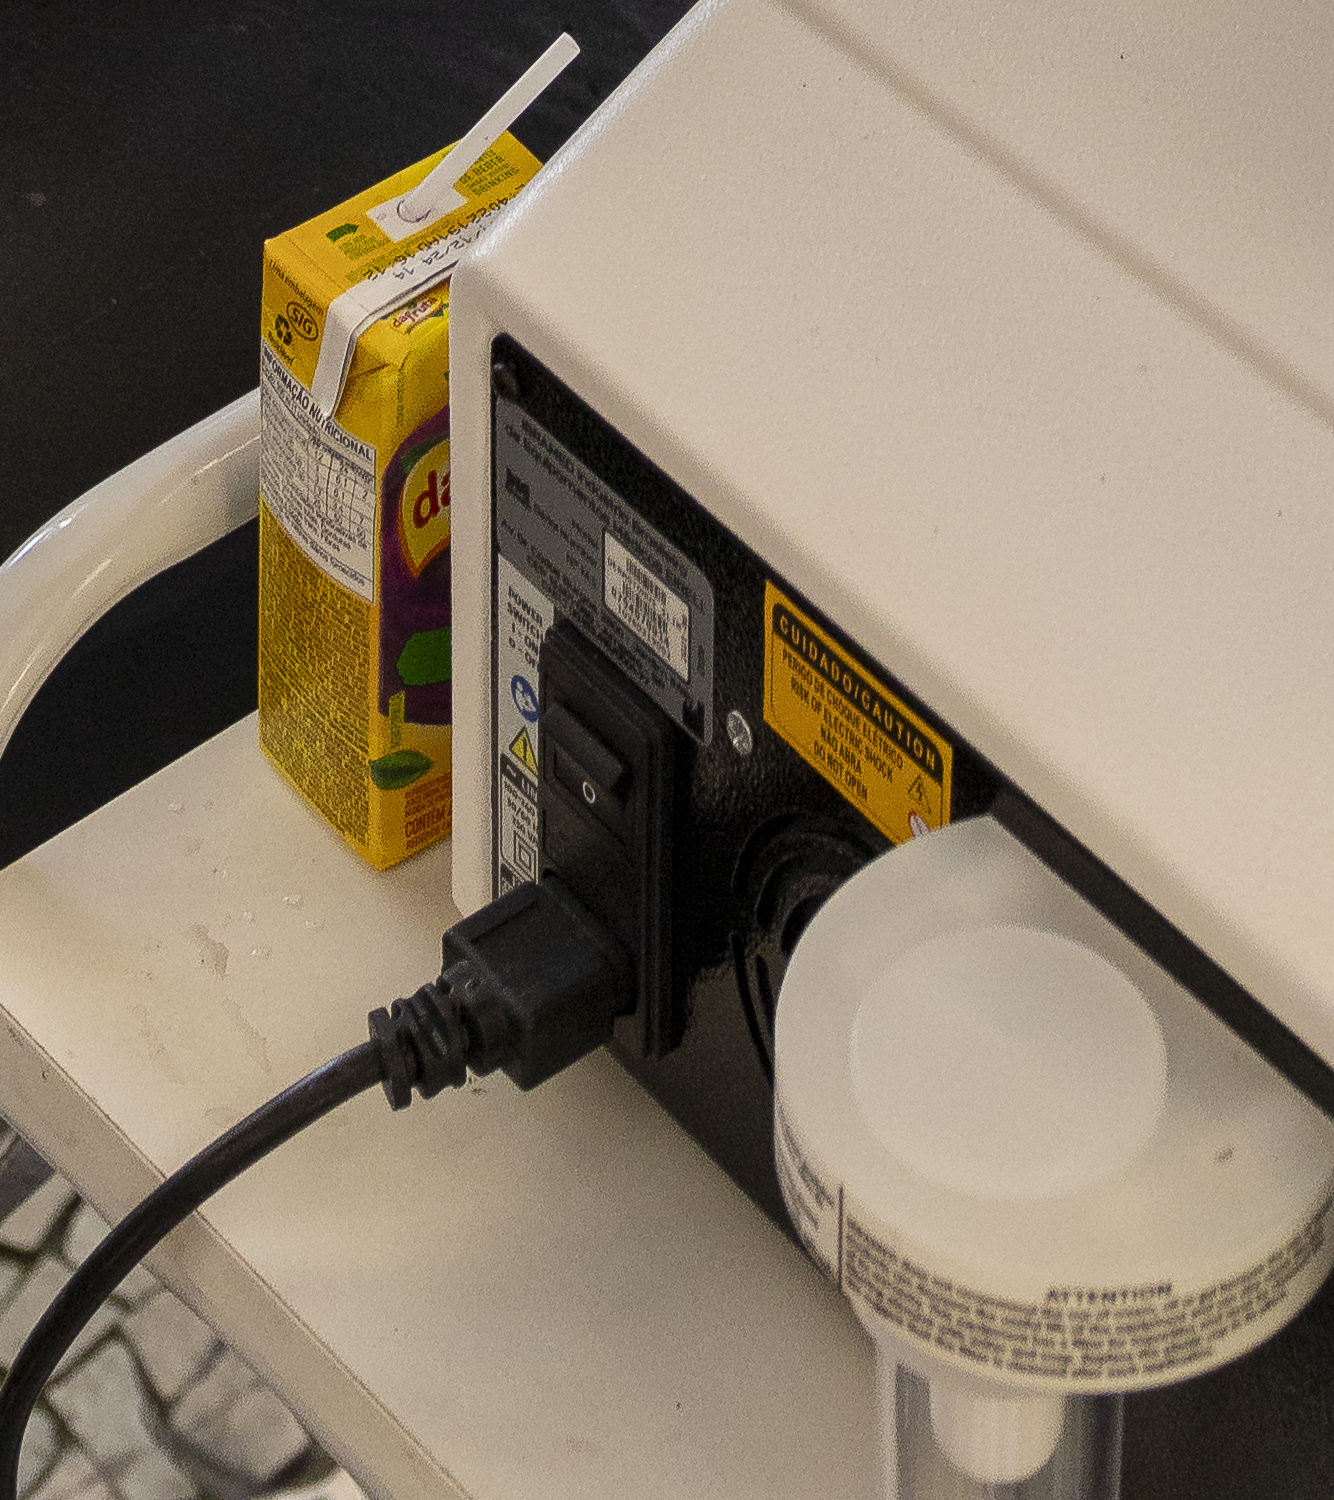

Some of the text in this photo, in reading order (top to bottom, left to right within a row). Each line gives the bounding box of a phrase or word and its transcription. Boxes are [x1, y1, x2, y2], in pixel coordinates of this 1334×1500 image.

[291, 306, 314, 336] SIG
[508, 585, 543, 628] POWER
[524, 651, 536, 669] OF
[779, 614, 935, 771] CUIDADO/CAUTION
[782, 647, 811, 687] PERIGO
[813, 675, 825, 699] DE
[826, 688, 860, 727] CHOQUE
[790, 675, 893, 785] RISK OF ELECTRIC SHOCK
[813, 739, 868, 801] DO NOT OPEN
[838, 741, 862, 775] ABRA
[521, 777, 538, 803] LIN
